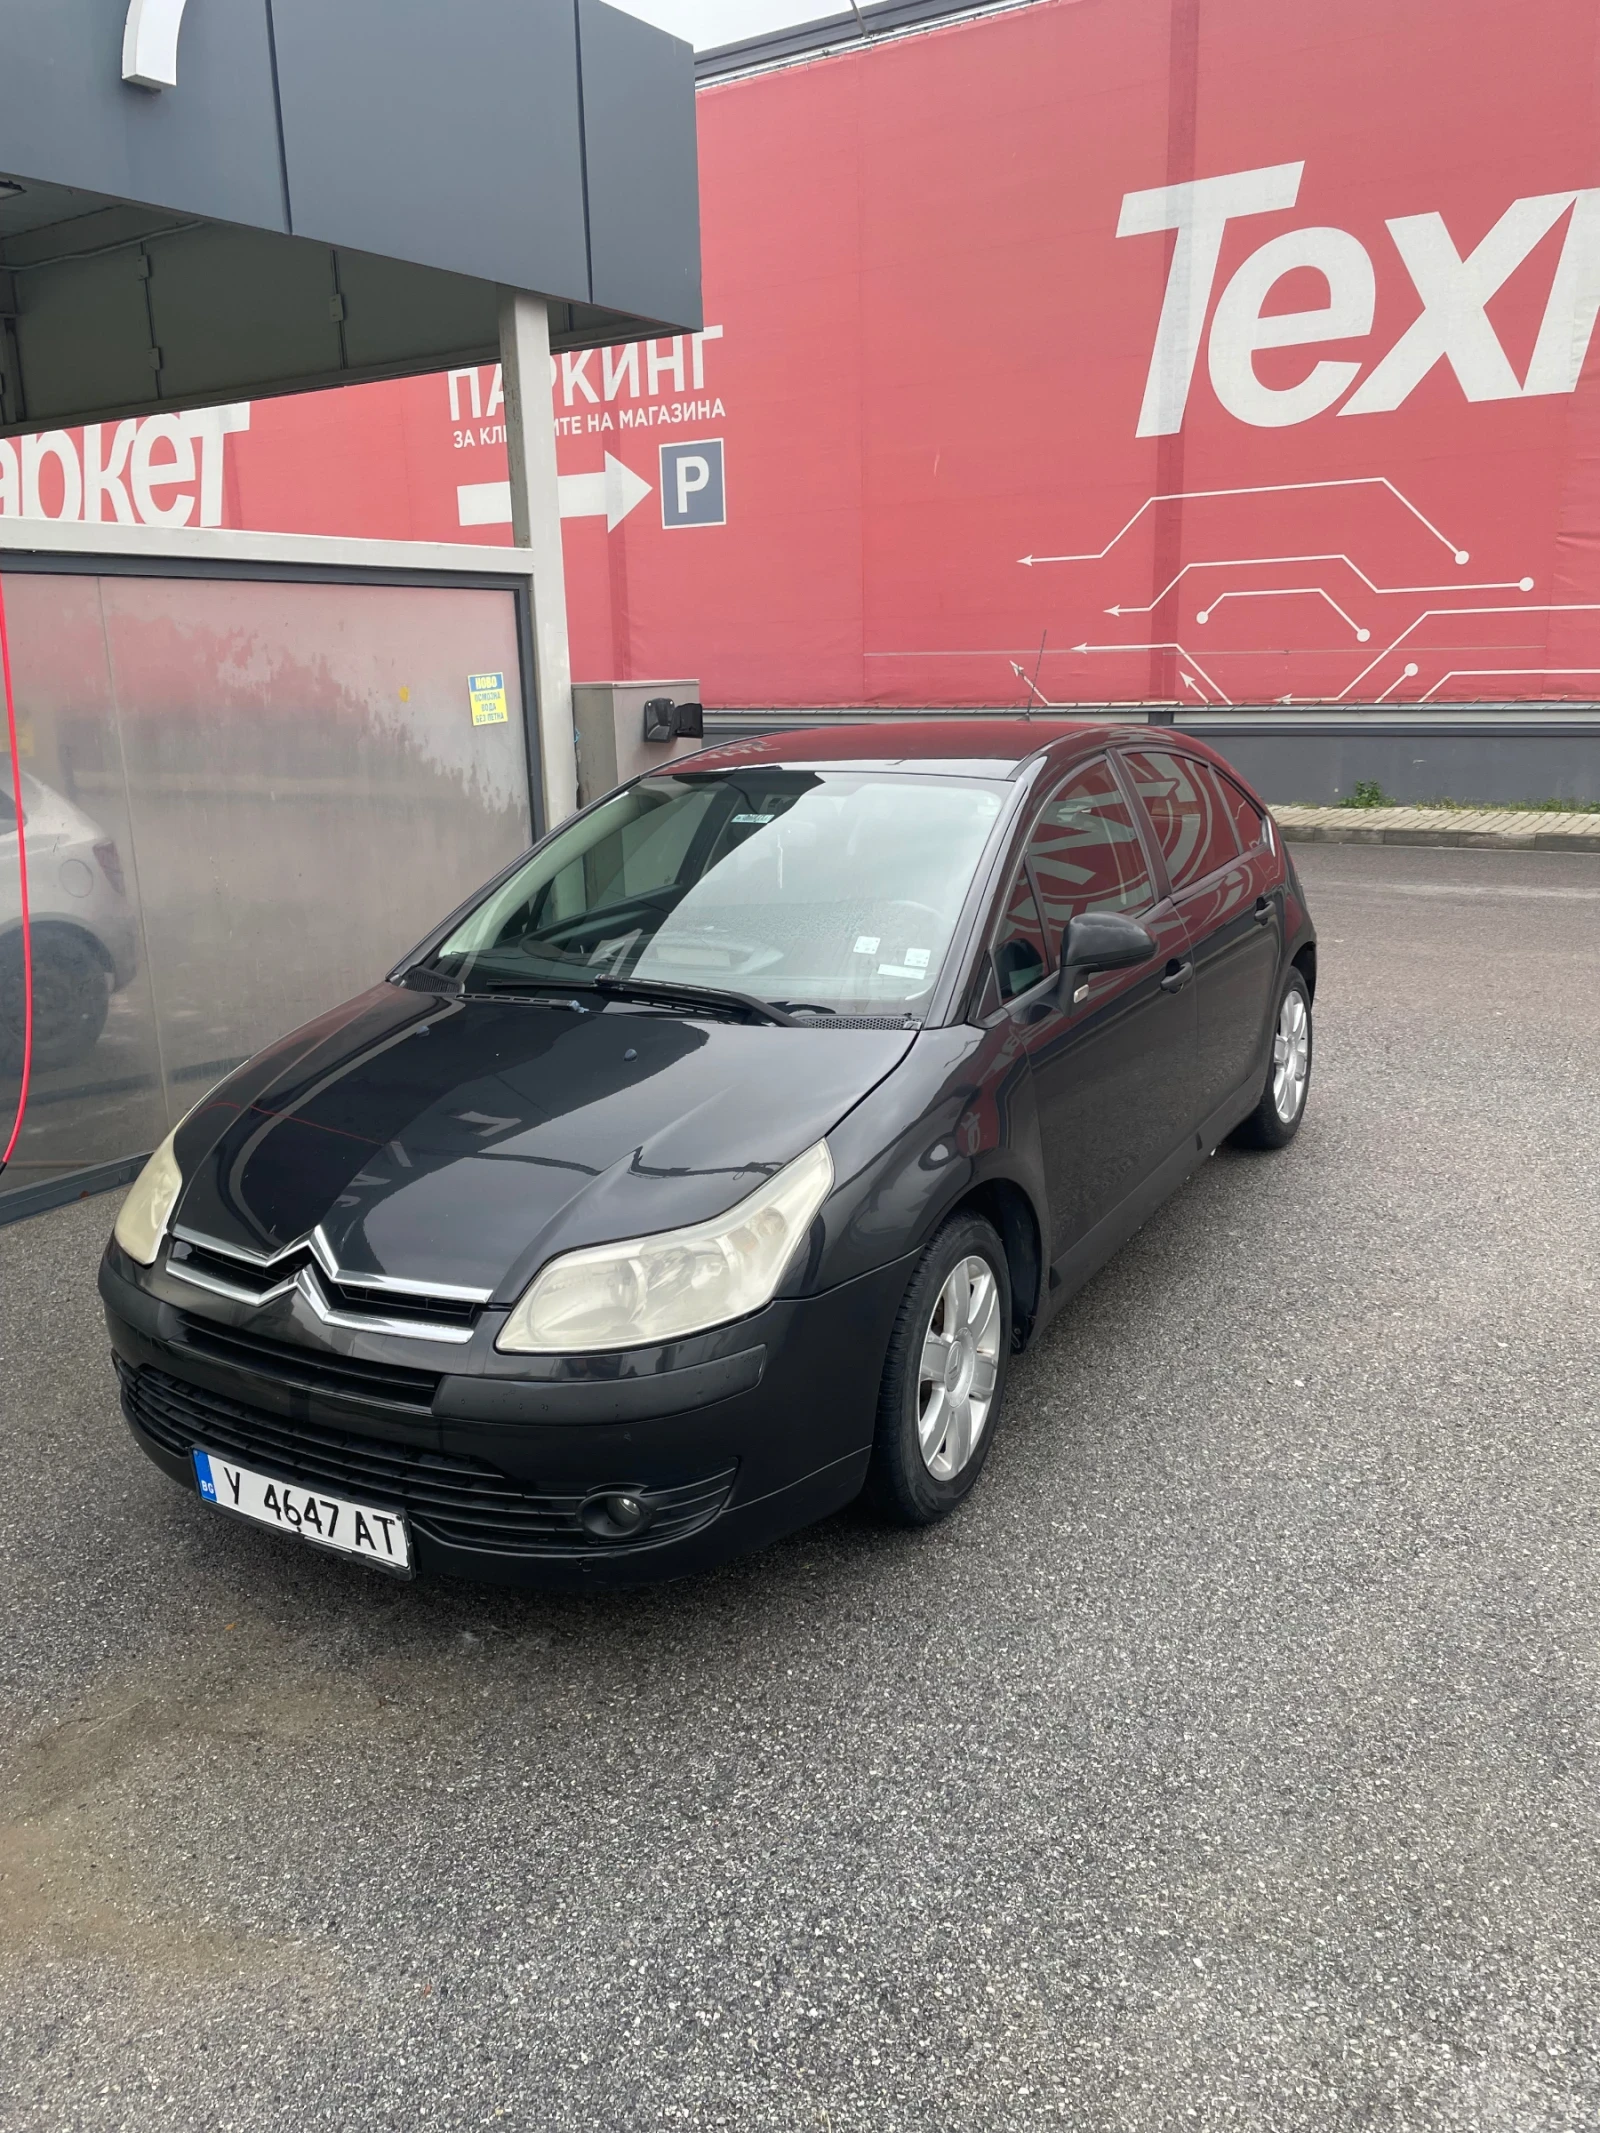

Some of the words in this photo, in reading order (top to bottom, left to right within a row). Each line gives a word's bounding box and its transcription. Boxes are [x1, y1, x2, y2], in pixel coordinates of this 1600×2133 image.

[453, 429, 476, 449] ЗА
[588, 412, 614, 433] НА
[619, 398, 726, 429] МАГАЗИНА
[676, 456, 710, 513] P
[475, 676, 498, 690] НОВО
[201, 1480, 215, 1494] BG
[264, 1484, 339, 1538] 4647
[355, 1510, 396, 1555] AT
